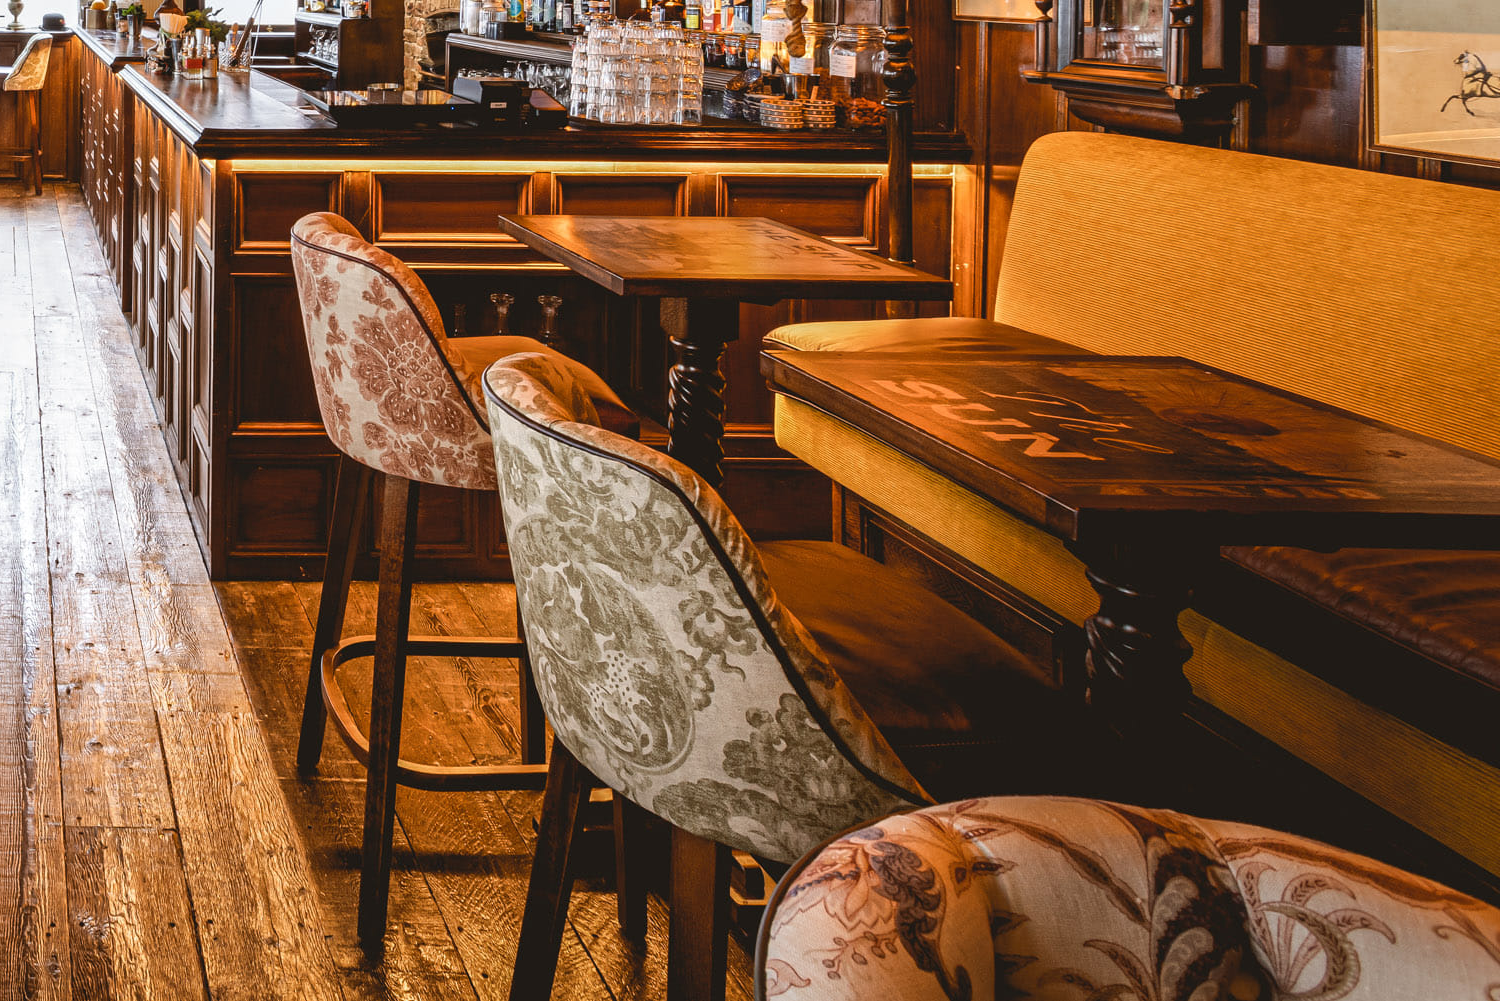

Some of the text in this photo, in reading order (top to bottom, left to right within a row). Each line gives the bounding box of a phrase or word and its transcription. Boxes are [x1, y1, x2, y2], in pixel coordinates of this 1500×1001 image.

[792, 244, 882, 270] SHIP
[872, 379, 1107, 461] SUN
[980, 390, 1174, 455] The
